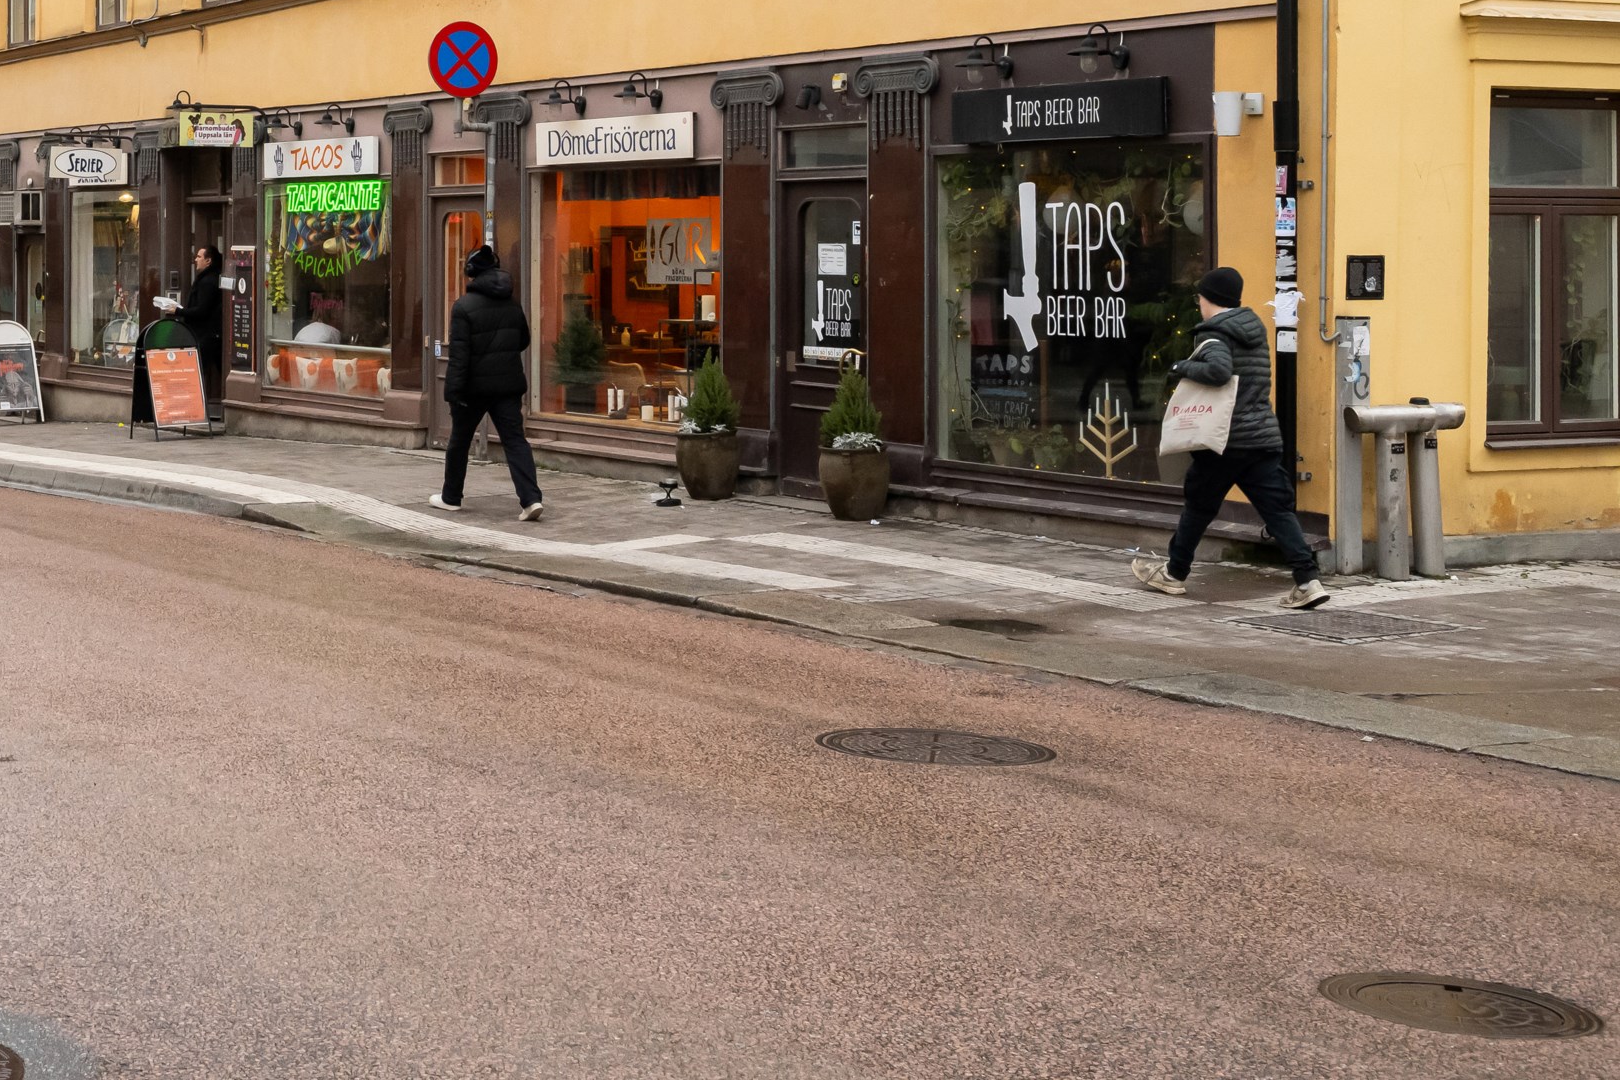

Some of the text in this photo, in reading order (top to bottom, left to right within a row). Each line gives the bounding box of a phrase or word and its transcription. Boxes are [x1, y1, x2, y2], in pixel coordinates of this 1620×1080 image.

[1015, 96, 1100, 128] TAPS BEER BAR
[290, 144, 343, 171] TACOS
[548, 126, 676, 158] DômeFrisörerna
[286, 181, 381, 213] TAPICANTE
[290, 242, 363, 279] TAPICANTE
[1045, 201, 1126, 292] TAPS
[825, 288, 852, 321] TAPS
[1046, 295, 1127, 339] BEER BAR
[825, 320, 851, 338] BEER BAR
[975, 353, 1030, 374] TAPS
[1004, 400, 1029, 417] CRAFT
